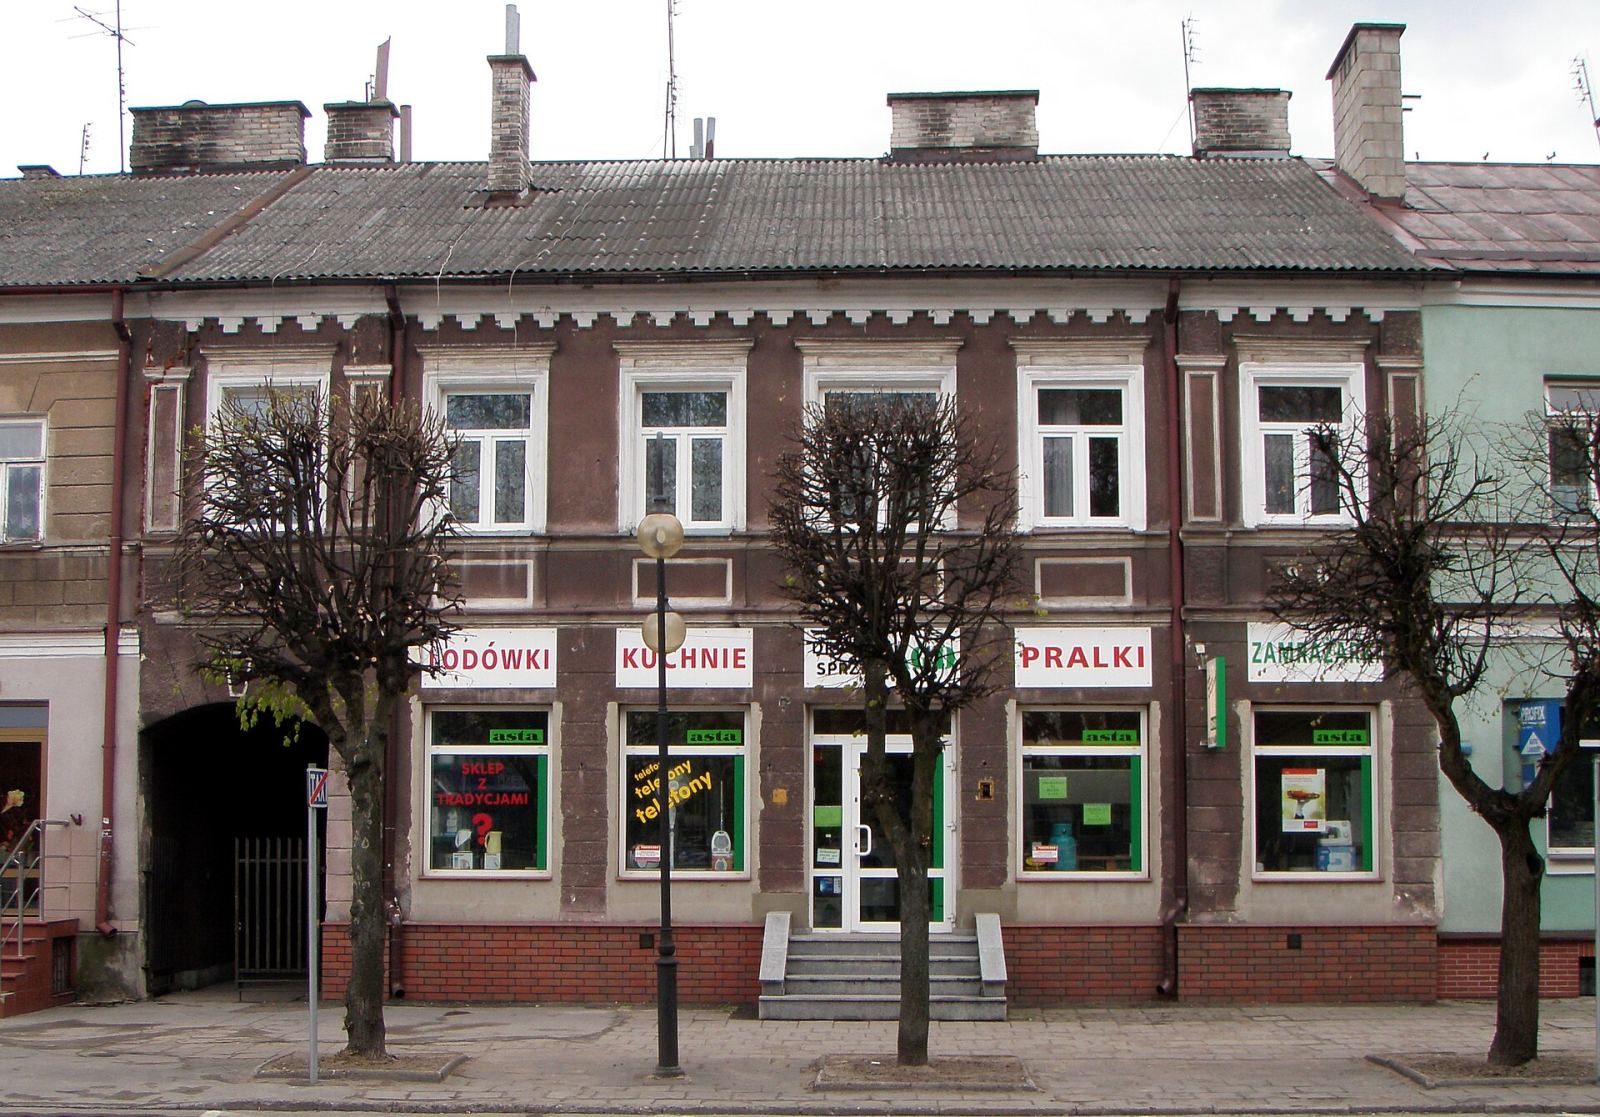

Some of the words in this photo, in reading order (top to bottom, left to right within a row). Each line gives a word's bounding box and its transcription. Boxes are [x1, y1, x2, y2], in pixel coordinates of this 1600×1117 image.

[1022, 646, 1145, 668] PRALKI
[492, 731, 539, 741] asta
[690, 731, 736, 741] asta
[1085, 731, 1132, 742] asta
[1316, 731, 1362, 742] asta
[462, 762, 505, 775] SKLEP
[635, 760, 692, 798] teleony
[437, 793, 529, 806] TRADYCJAMI
